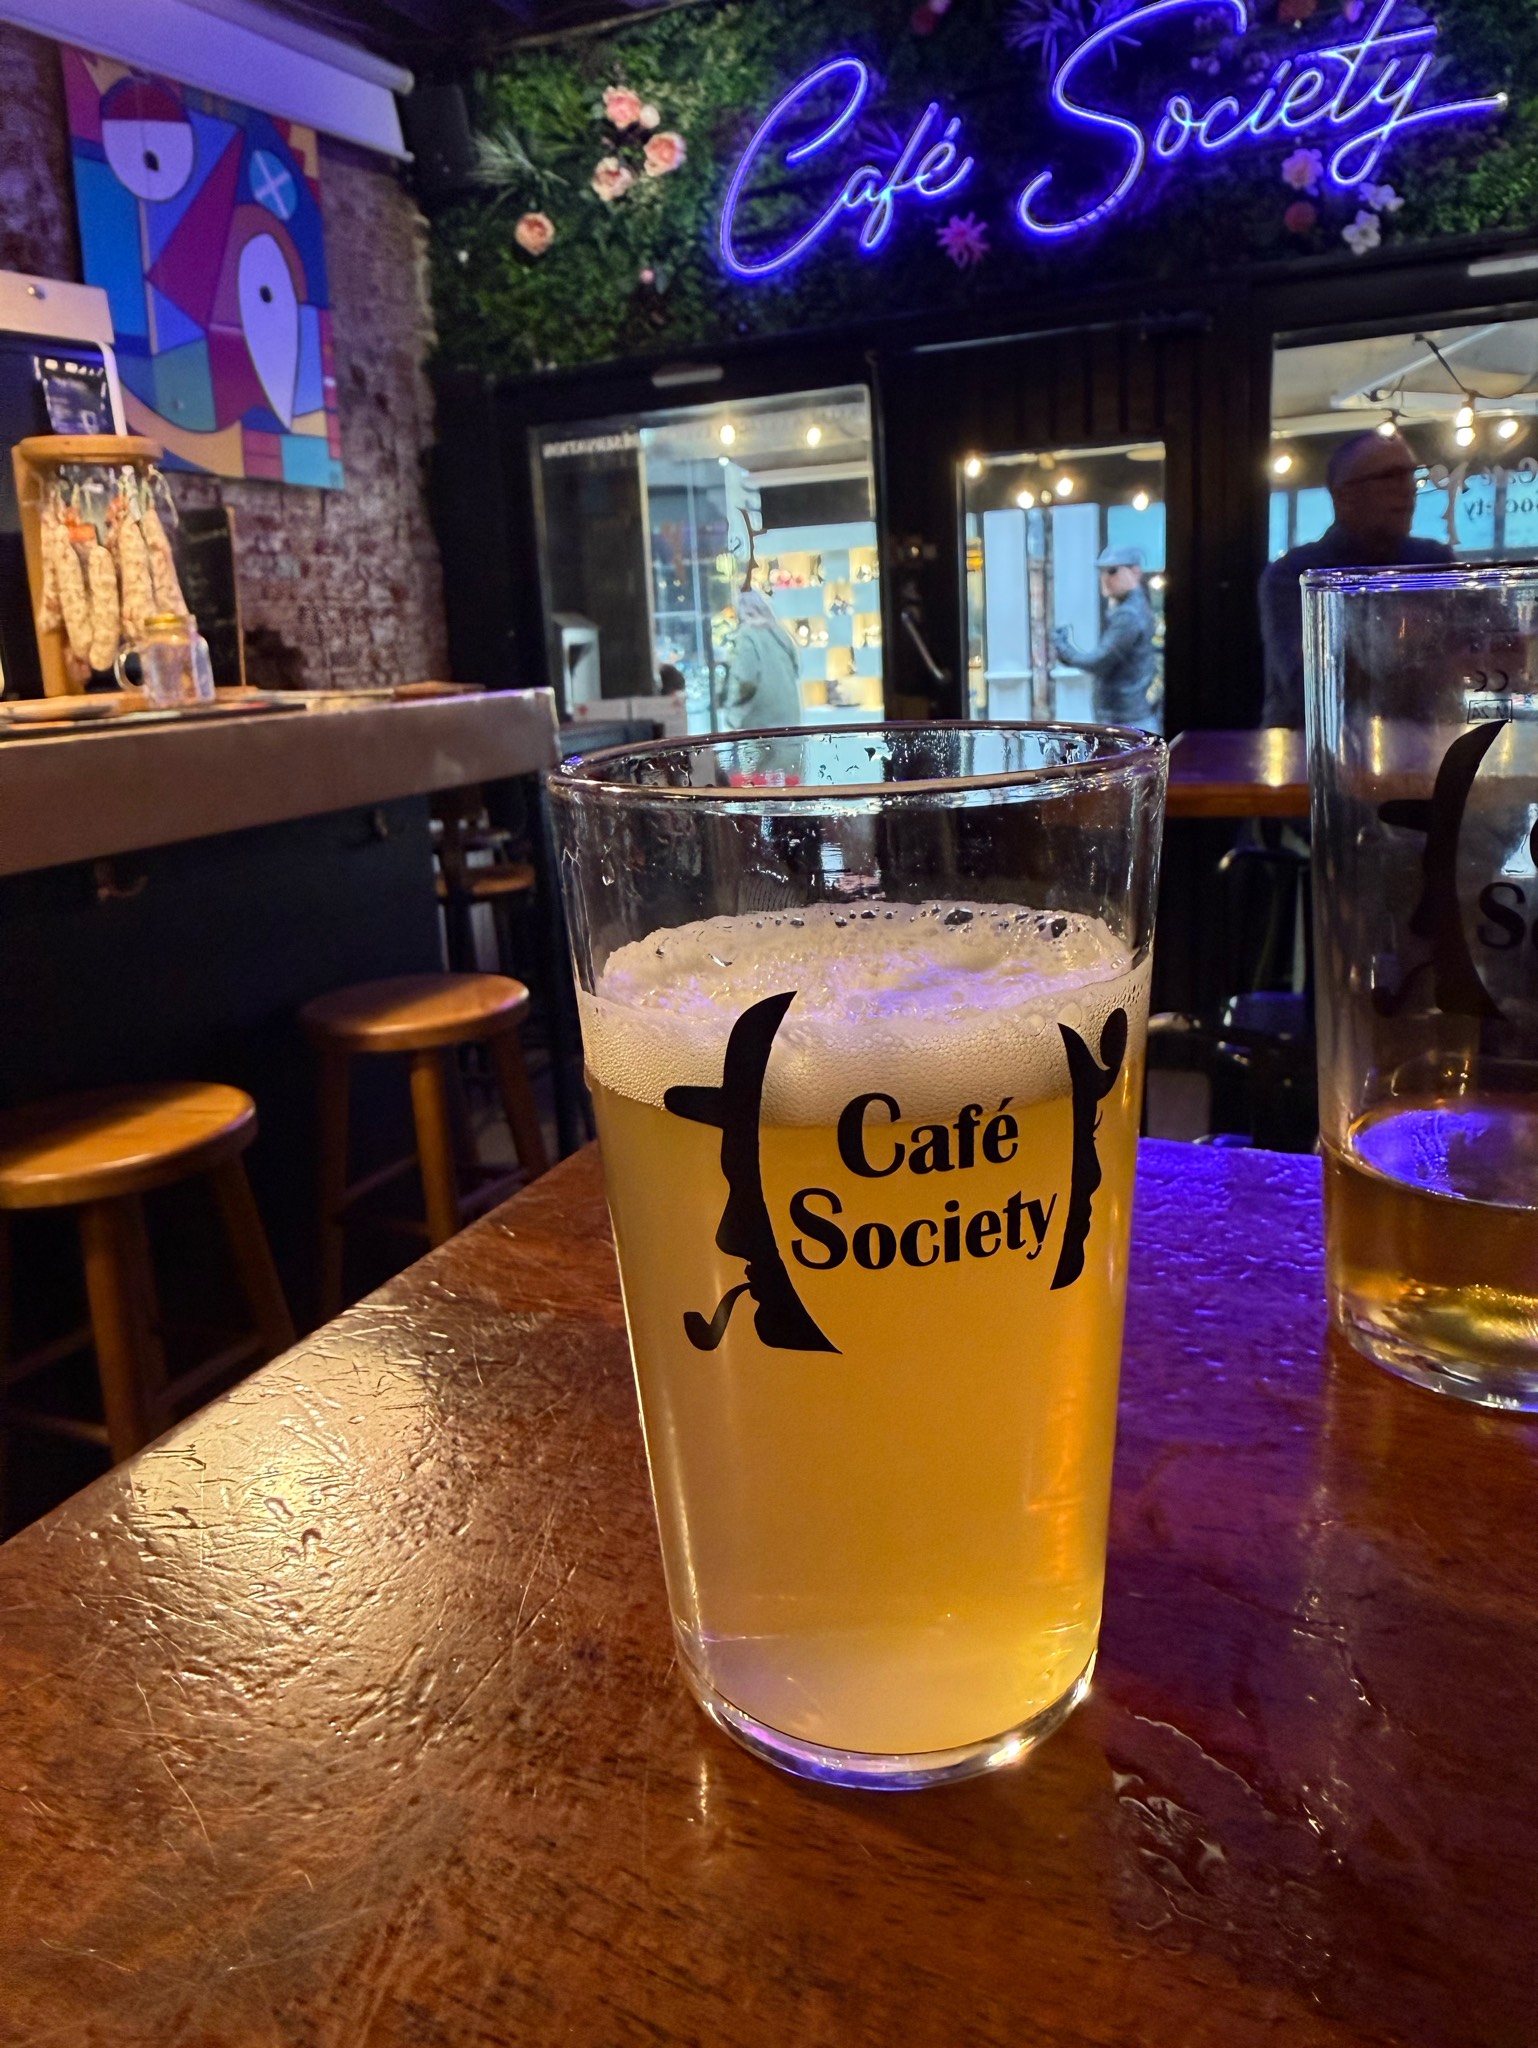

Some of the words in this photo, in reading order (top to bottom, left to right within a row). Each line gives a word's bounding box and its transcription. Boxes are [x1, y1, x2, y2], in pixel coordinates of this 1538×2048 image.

[720, 56, 976, 277] Café
[1016, 0, 1509, 236] Society
[1476, 881, 1538, 949] S
[836, 1092, 1019, 1179] Café
[788, 1188, 1058, 1271] Society
